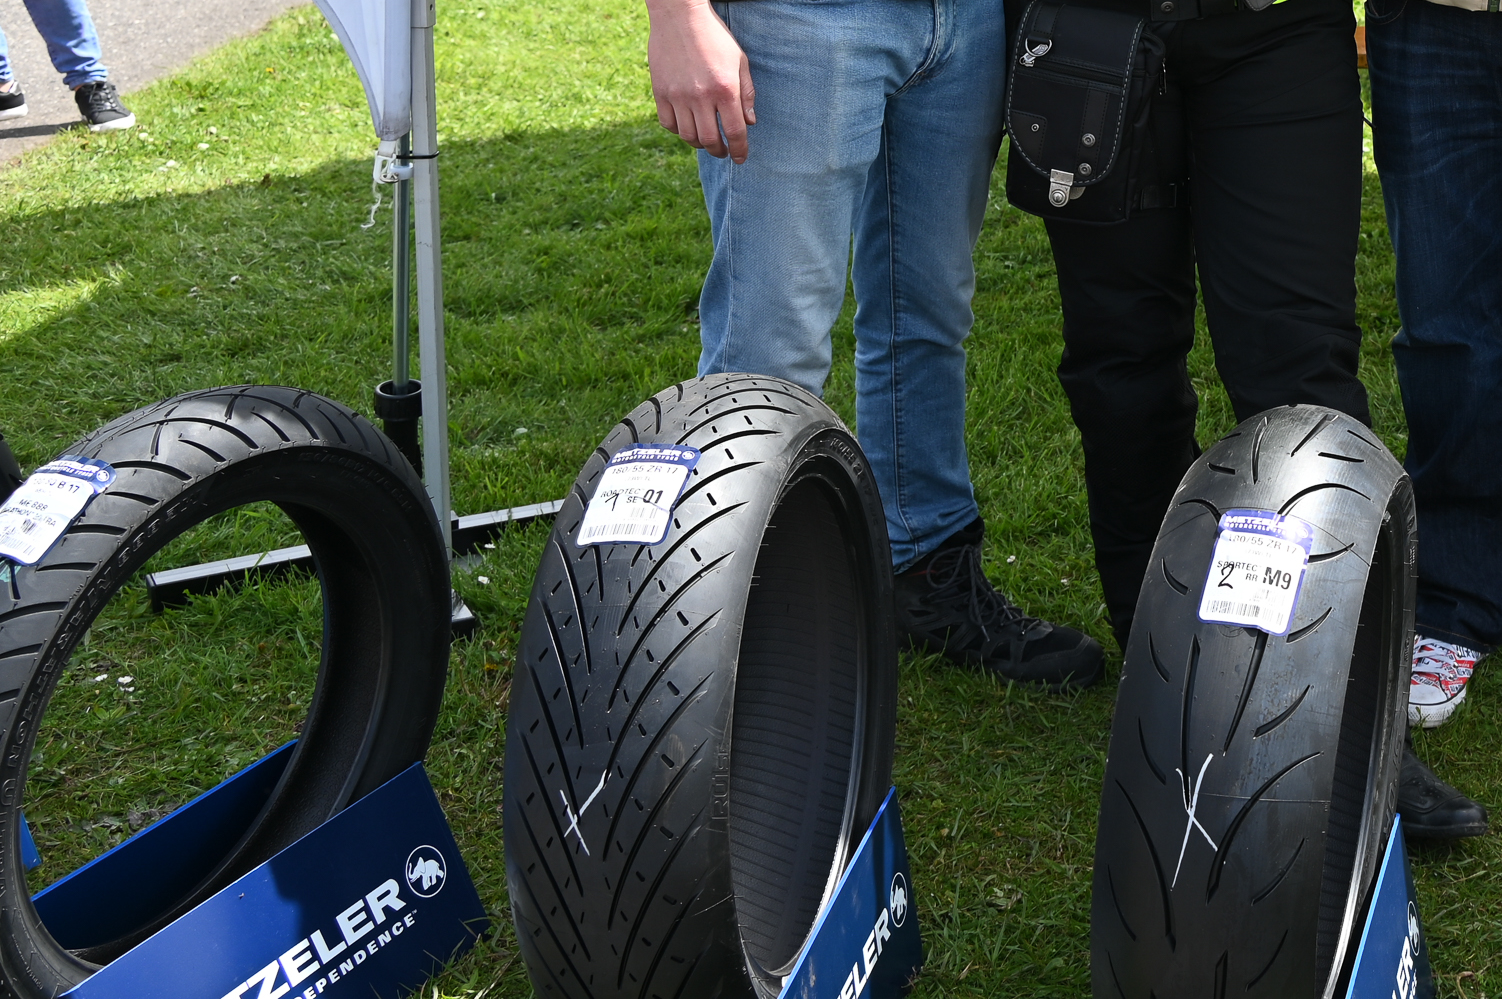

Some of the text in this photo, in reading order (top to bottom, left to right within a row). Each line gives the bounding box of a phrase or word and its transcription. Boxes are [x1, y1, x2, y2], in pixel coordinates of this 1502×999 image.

[614, 448, 683, 458] METZELER
[612, 465, 644, 474] 180/55
[646, 465, 662, 473] ZR
[626, 489, 664, 504] SE 01
[1245, 566, 1292, 590] RR M9
